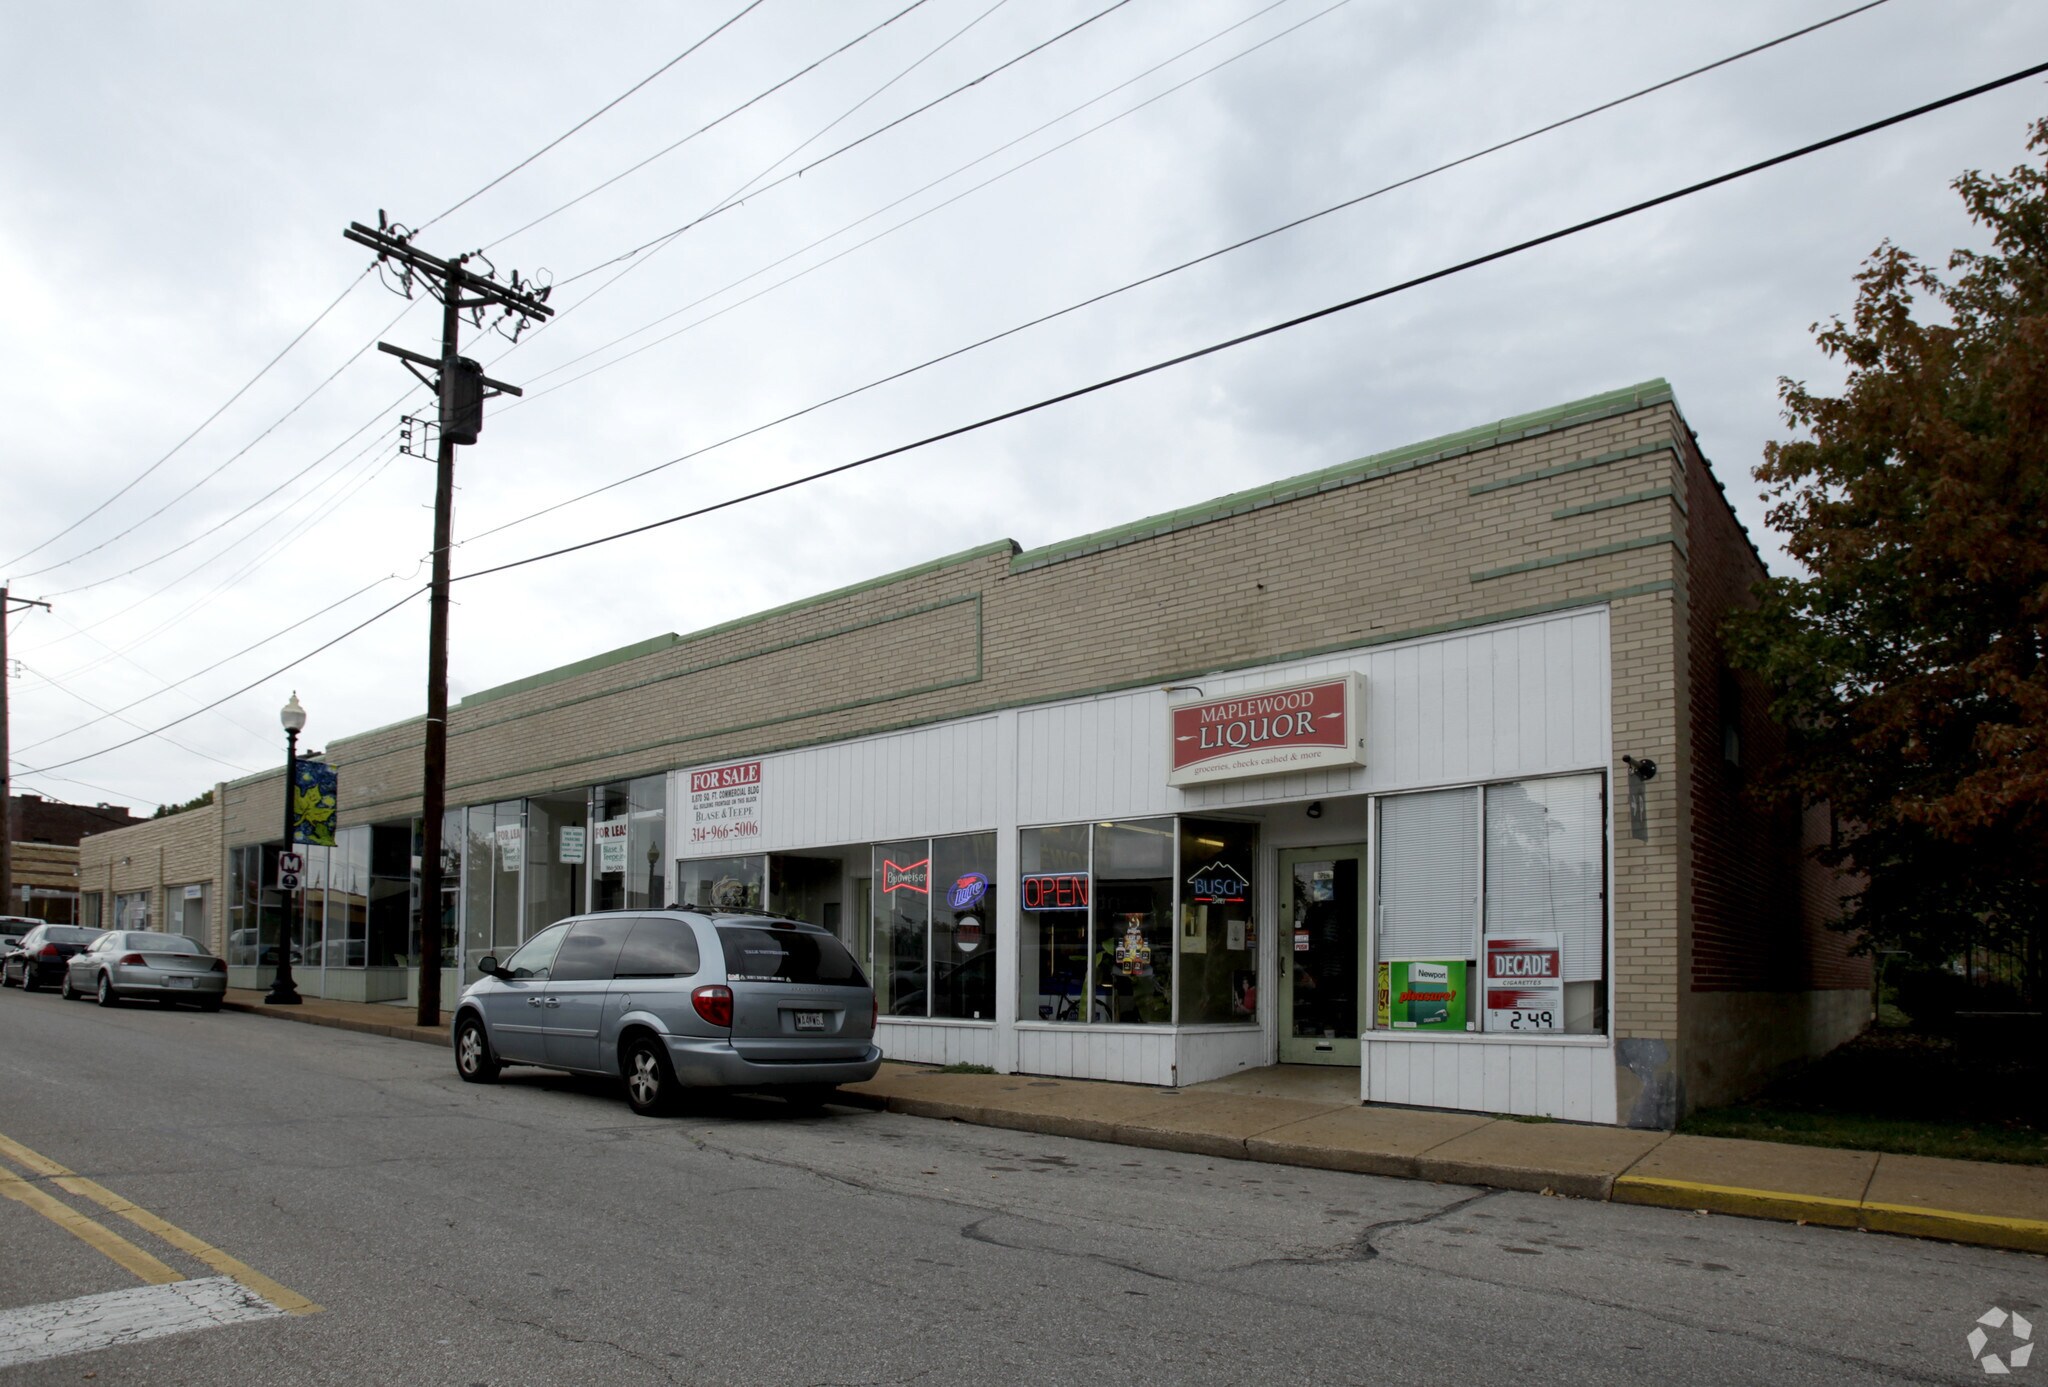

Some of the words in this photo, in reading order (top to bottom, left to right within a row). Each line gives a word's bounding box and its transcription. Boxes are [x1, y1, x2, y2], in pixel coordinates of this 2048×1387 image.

[1200, 691, 1314, 724] MAPLEWOOD
[1199, 712, 1316, 750] LIQUOR
[1194, 760, 1230, 776] groceries,
[1232, 757, 1258, 769] checks
[1261, 754, 1288, 766] cashed
[1290, 752, 1297, 760] &
[1300, 751, 1322, 760] more
[693, 772, 719, 790] FOR
[722, 764, 758, 786] SALE
[719, 788, 746, 799] COMMERCIAL
[748, 786, 759, 795] BLDG
[696, 811, 720, 822] BLASE
[728, 806, 753, 817] TEEPE
[700, 802, 713, 810] BUILDING
[498, 830, 509, 841] FOR
[595, 827, 609, 839] FOR
[691, 820, 758, 842] 314-966-5006
[283, 856, 299, 871] M
[887, 872, 927, 884] Budweiser
[1025, 877, 1089, 906] OPEN
[1194, 878, 1243, 895] BUSCH
[1211, 894, 1226, 904] Beer
[1494, 954, 1552, 976] DECADE
[1418, 969, 1446, 979] Newport
[1398, 989, 1456, 1004] pleasure!
[1510, 1011, 1553, 1030] 2.49
